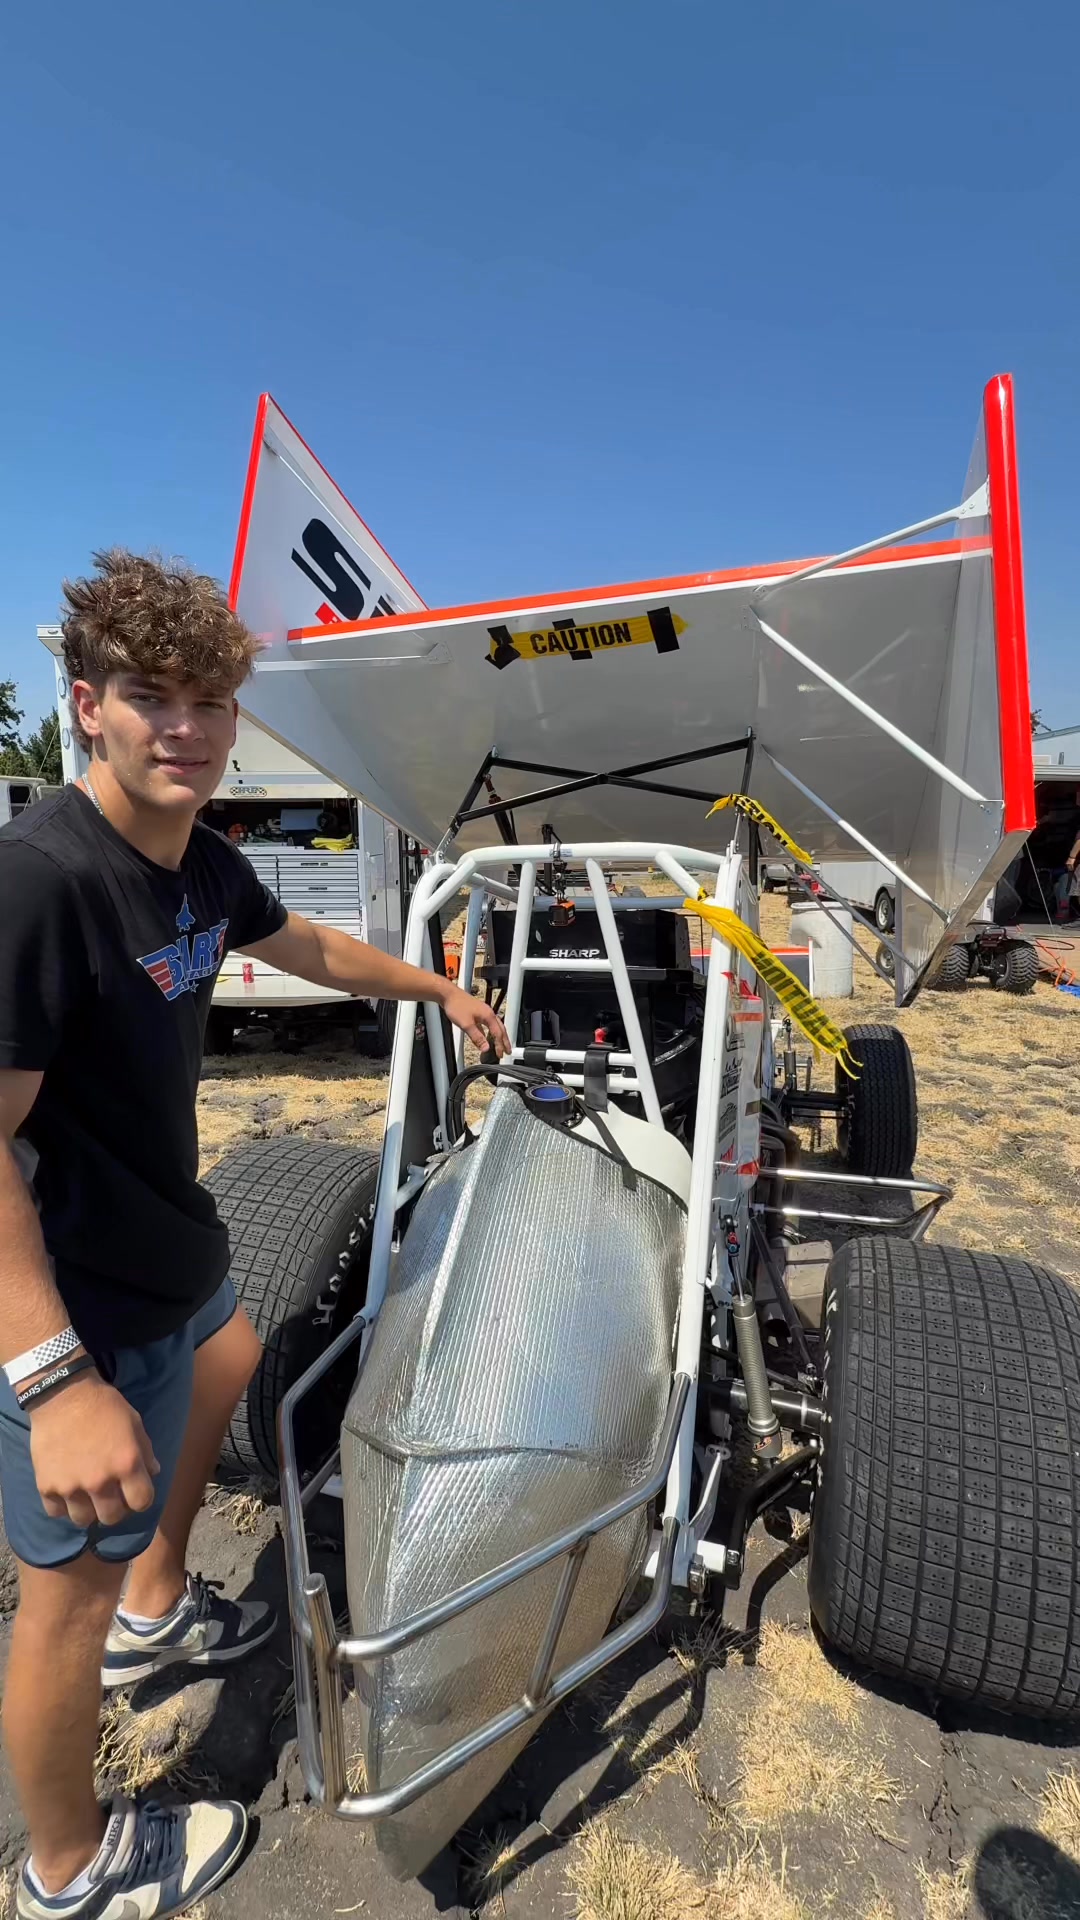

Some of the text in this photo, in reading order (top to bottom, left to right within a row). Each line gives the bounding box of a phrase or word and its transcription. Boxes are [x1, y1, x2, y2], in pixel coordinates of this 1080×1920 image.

[529, 621, 633, 655] CAUTION
[150, 920, 228, 988] SRP
[549, 948, 600, 958] SHARP
[41, 1367, 69, 1388] Ryder
[106, 1816, 121, 1846] NIKE
